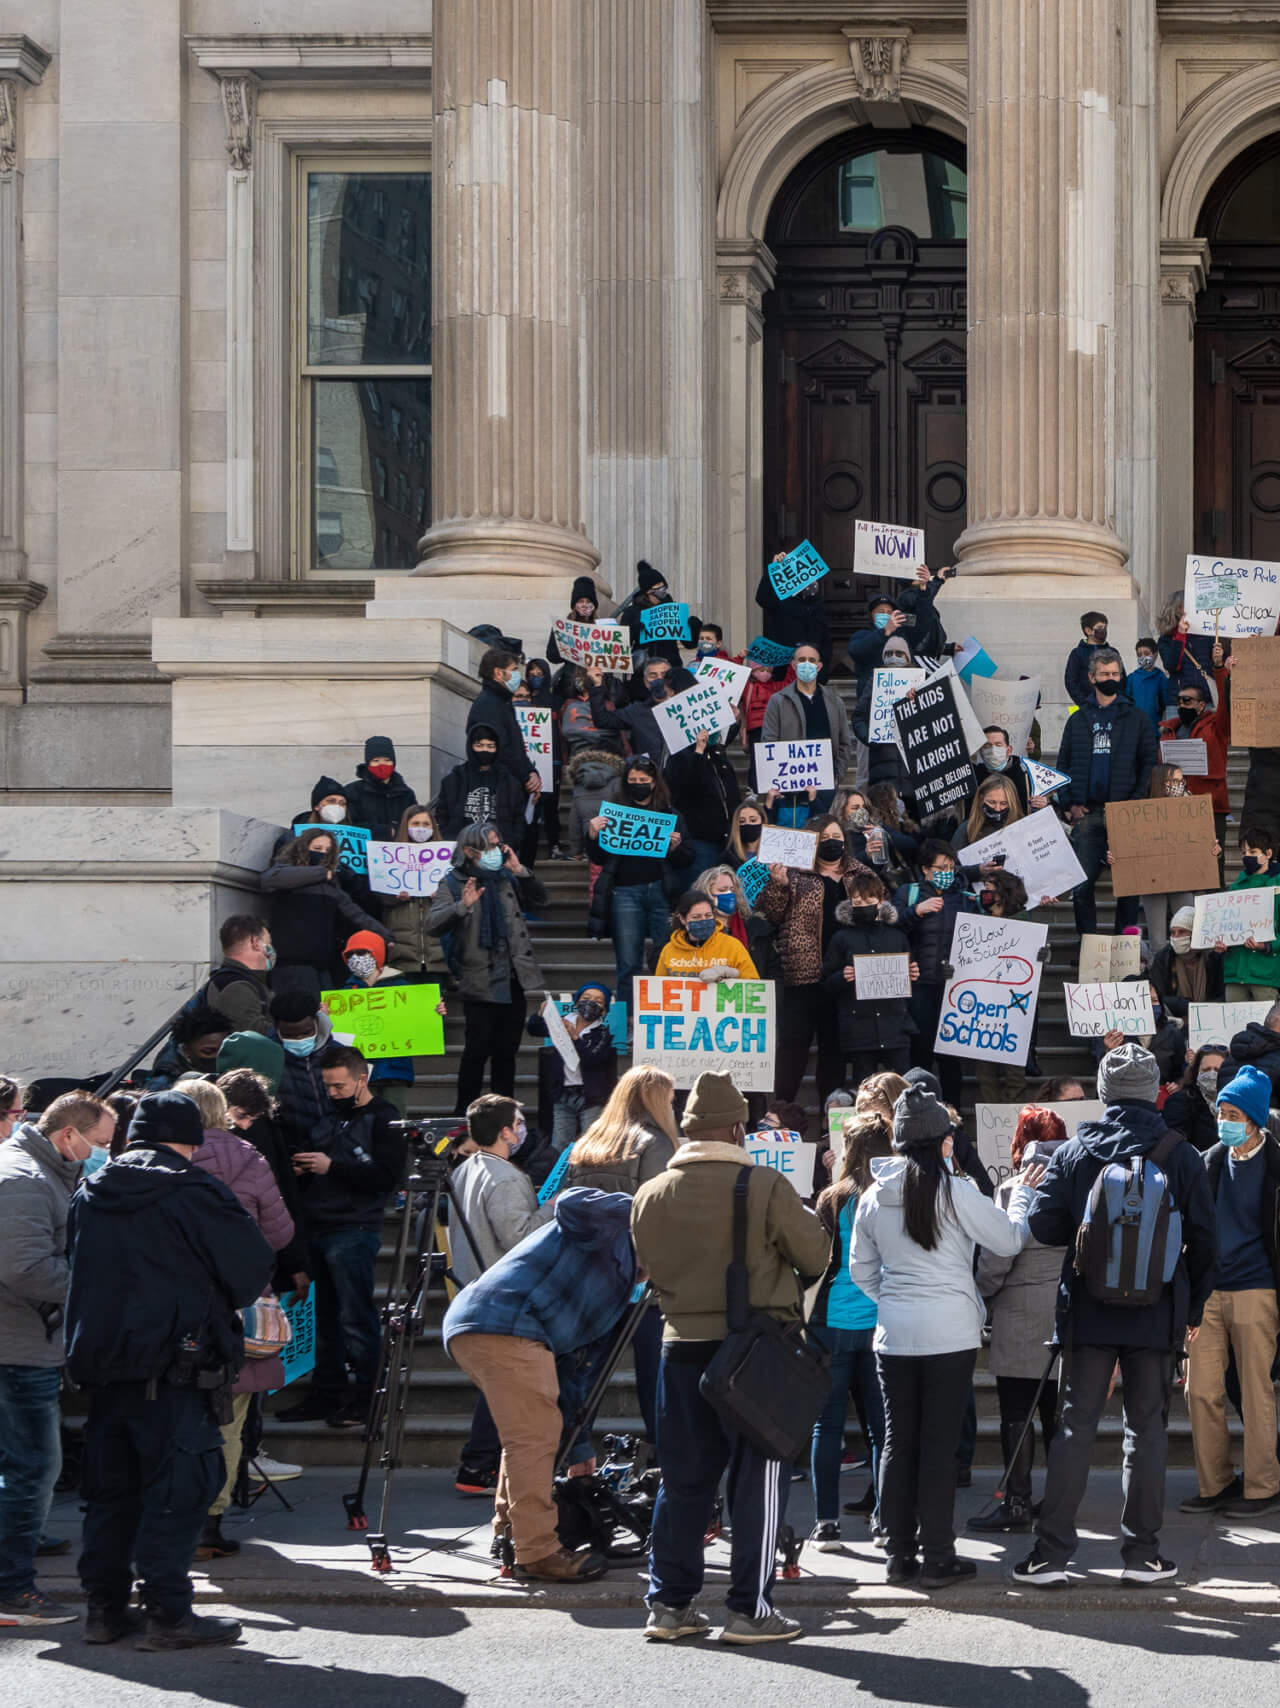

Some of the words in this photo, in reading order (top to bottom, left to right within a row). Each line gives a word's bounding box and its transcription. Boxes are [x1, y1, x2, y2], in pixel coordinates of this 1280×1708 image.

[875, 535, 916, 561] NOW!
[772, 553, 818, 587] REAL
[778, 565, 825, 595] SCHOOL
[1193, 560, 1204, 576] 2
[1212, 561, 1248, 578] Case
[1253, 567, 1278, 584] Rule
[1232, 604, 1276, 620] SCHOOL
[556, 620, 590, 639] OPEN
[591, 629, 622, 642] OUR
[644, 626, 686, 641] NOW.
[584, 654, 630, 670] DAYS
[699, 664, 737, 682] BACK
[877, 672, 908, 688] Follow
[686, 686, 717, 706] MORE
[897, 700, 918, 721] THE
[919, 685, 945, 711] KIDS
[676, 700, 721, 729] 2-CASE
[685, 717, 719, 743] RULE
[908, 725, 928, 750] ARE
[932, 714, 955, 736] NOT
[765, 744, 775, 761] I
[788, 744, 823, 758] HATE
[916, 739, 961, 775] ALRIGHT
[778, 762, 818, 776] ZOOM
[915, 785, 929, 800] NYC
[929, 775, 944, 794] KIDS
[945, 763, 971, 786] BELONG
[772, 777, 822, 791] SCHOOL
[925, 801, 934, 813] IN
[939, 783, 969, 807] SCHOOL!
[604, 808, 623, 817] OUR
[626, 813, 646, 822] KIDS
[648, 817, 671, 825] NEED
[1120, 804, 1168, 824] OPEN
[601, 816, 666, 841] REAL
[601, 834, 663, 852] SCHOOL
[1206, 894, 1261, 912] EUROPE
[957, 923, 1008, 955] Follow
[710, 957, 728, 967] Are
[959, 955, 973, 967] the
[973, 937, 1020, 962] Science
[325, 991, 408, 1016] OPEN
[638, 980, 708, 1012] LET
[716, 982, 767, 1014] ME
[957, 990, 1008, 1020] Open
[1067, 983, 1113, 1012] Kids
[1114, 982, 1151, 1011] don't
[638, 1015, 766, 1053] TEACH
[939, 1012, 1018, 1052] Schools
[1070, 1012, 1105, 1035] have
[1105, 1010, 1146, 1033] Union
[750, 1149, 795, 1172] THE
